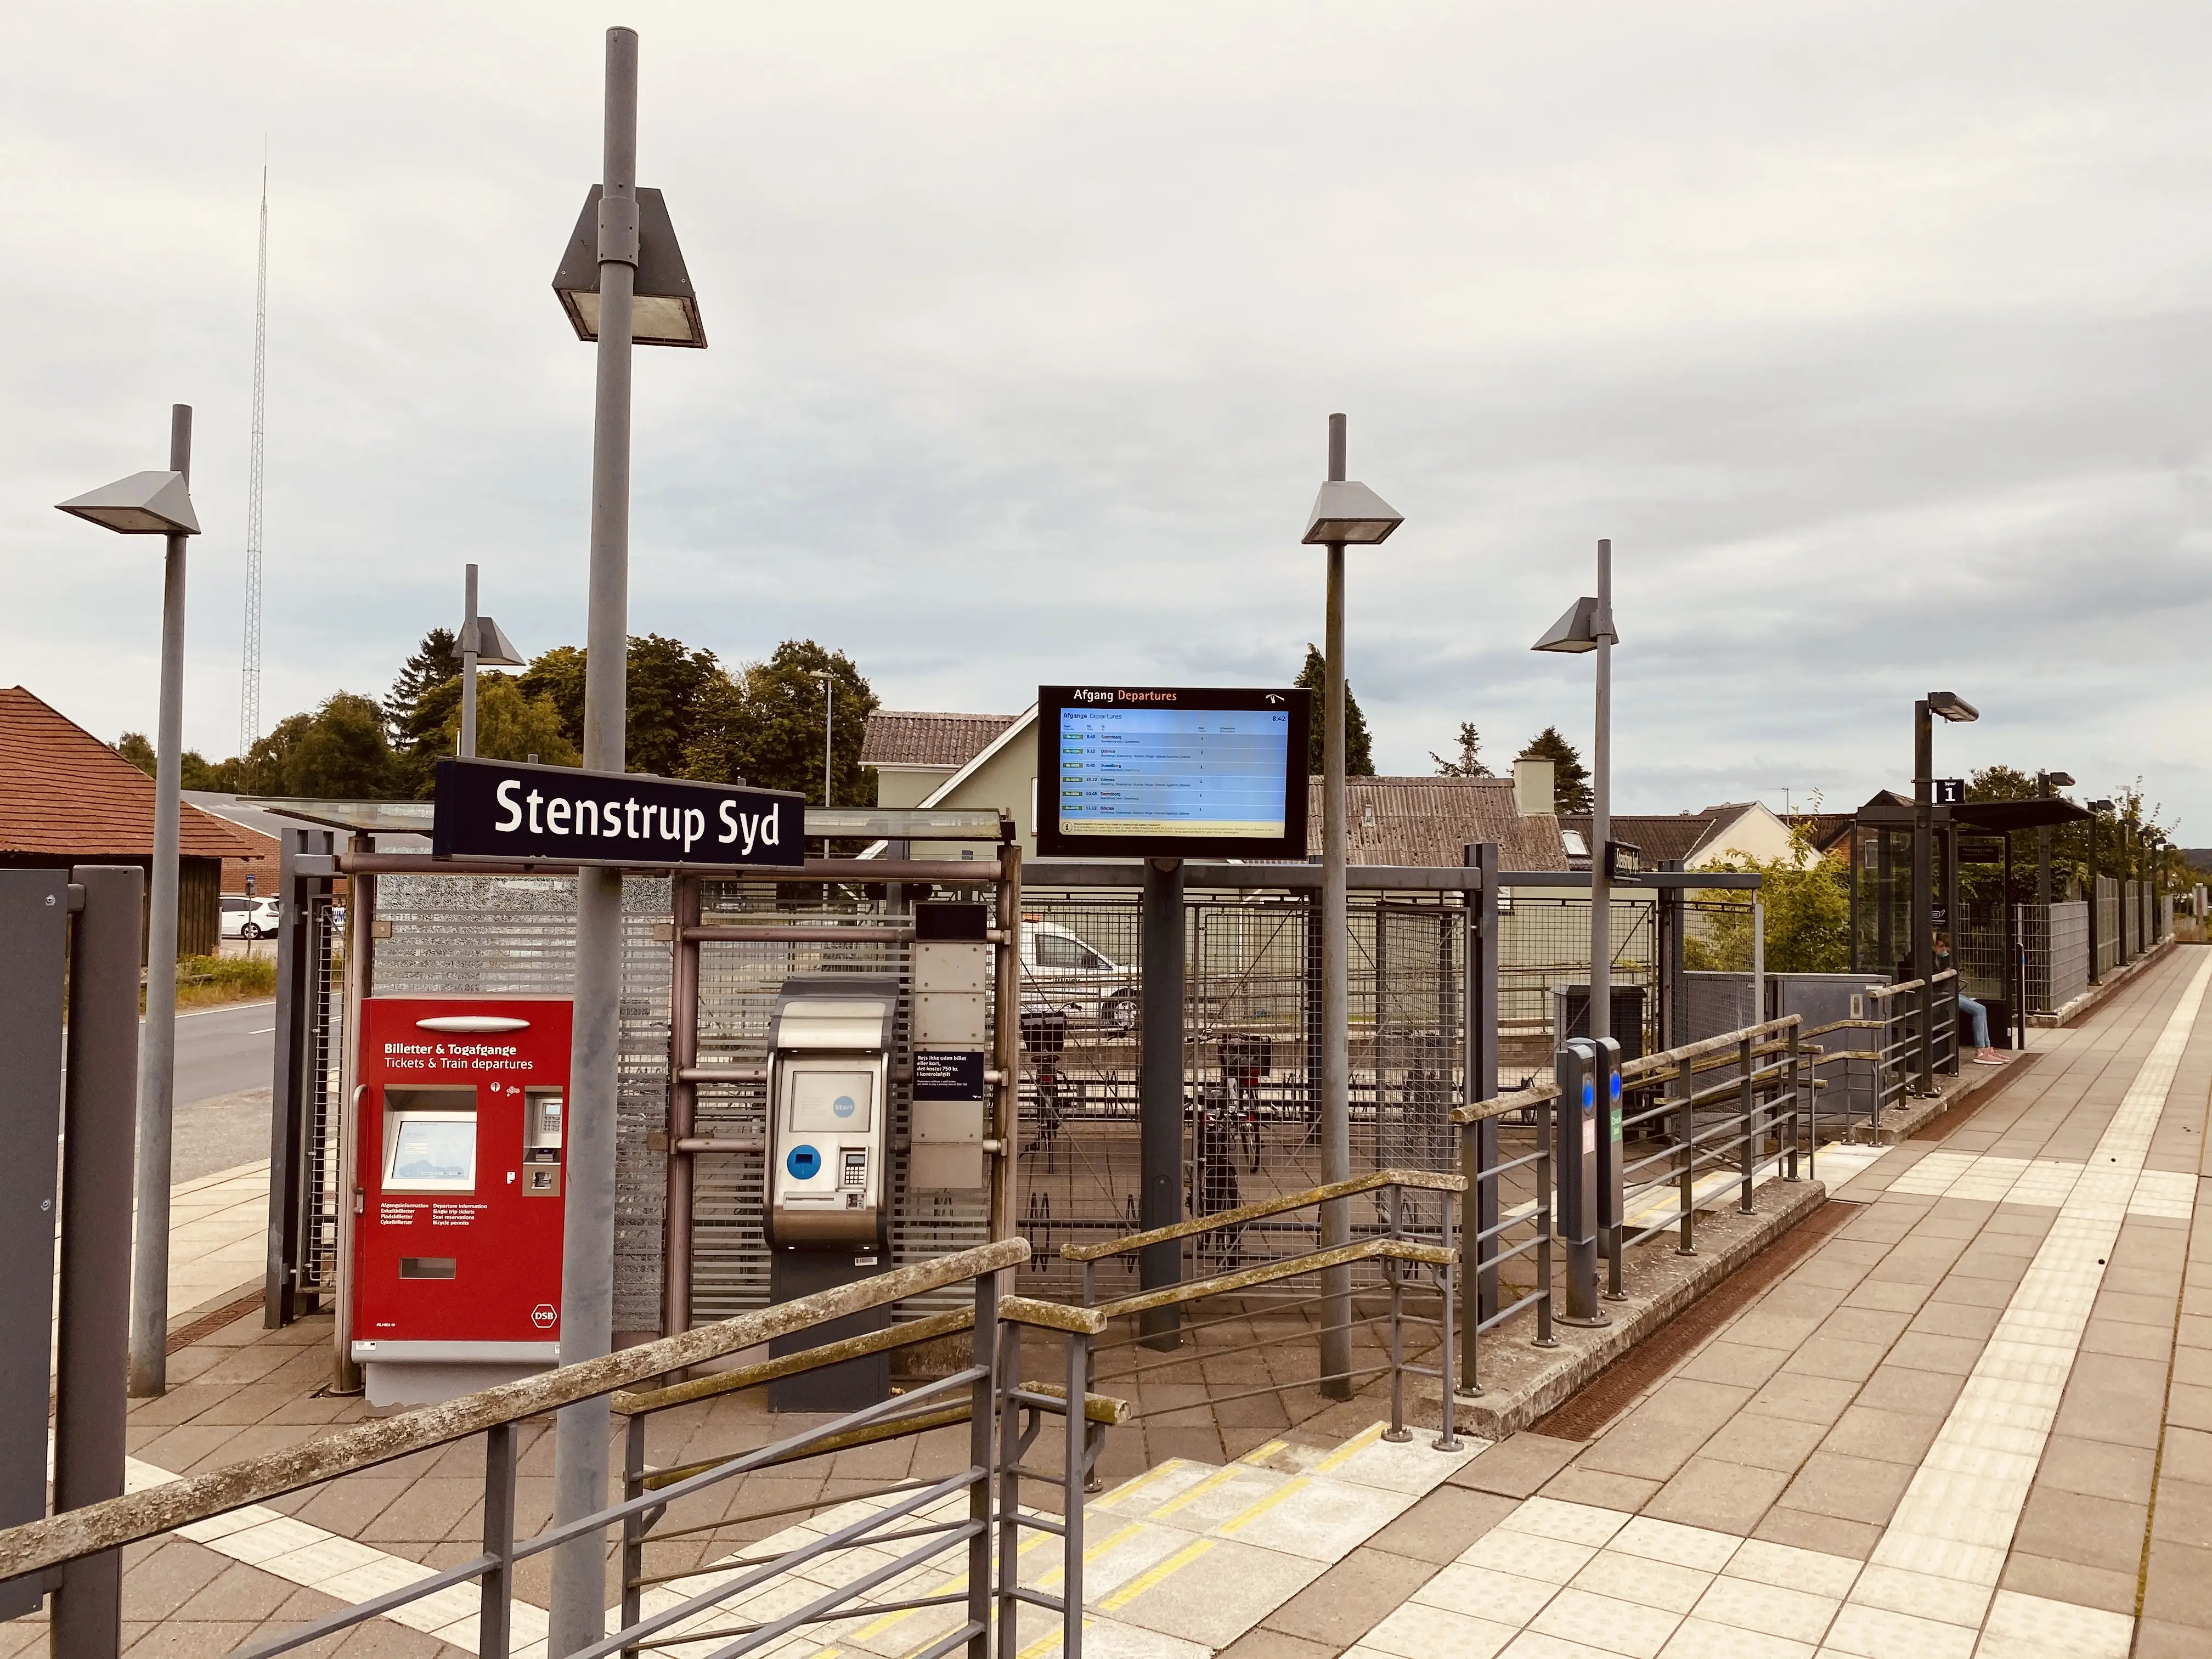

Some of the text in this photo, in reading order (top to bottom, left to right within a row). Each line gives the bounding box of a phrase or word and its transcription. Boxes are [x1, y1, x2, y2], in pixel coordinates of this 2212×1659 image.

[1074, 689, 1177, 703] Afgang Departures
[1945, 787, 1956, 802] 1
[494, 779, 780, 856] Stenstrup Syd
[384, 1043, 517, 1057] Billetter & Togafgange
[384, 1057, 533, 1071] Tickets & Train departures
[534, 1312, 554, 1321] DSB
